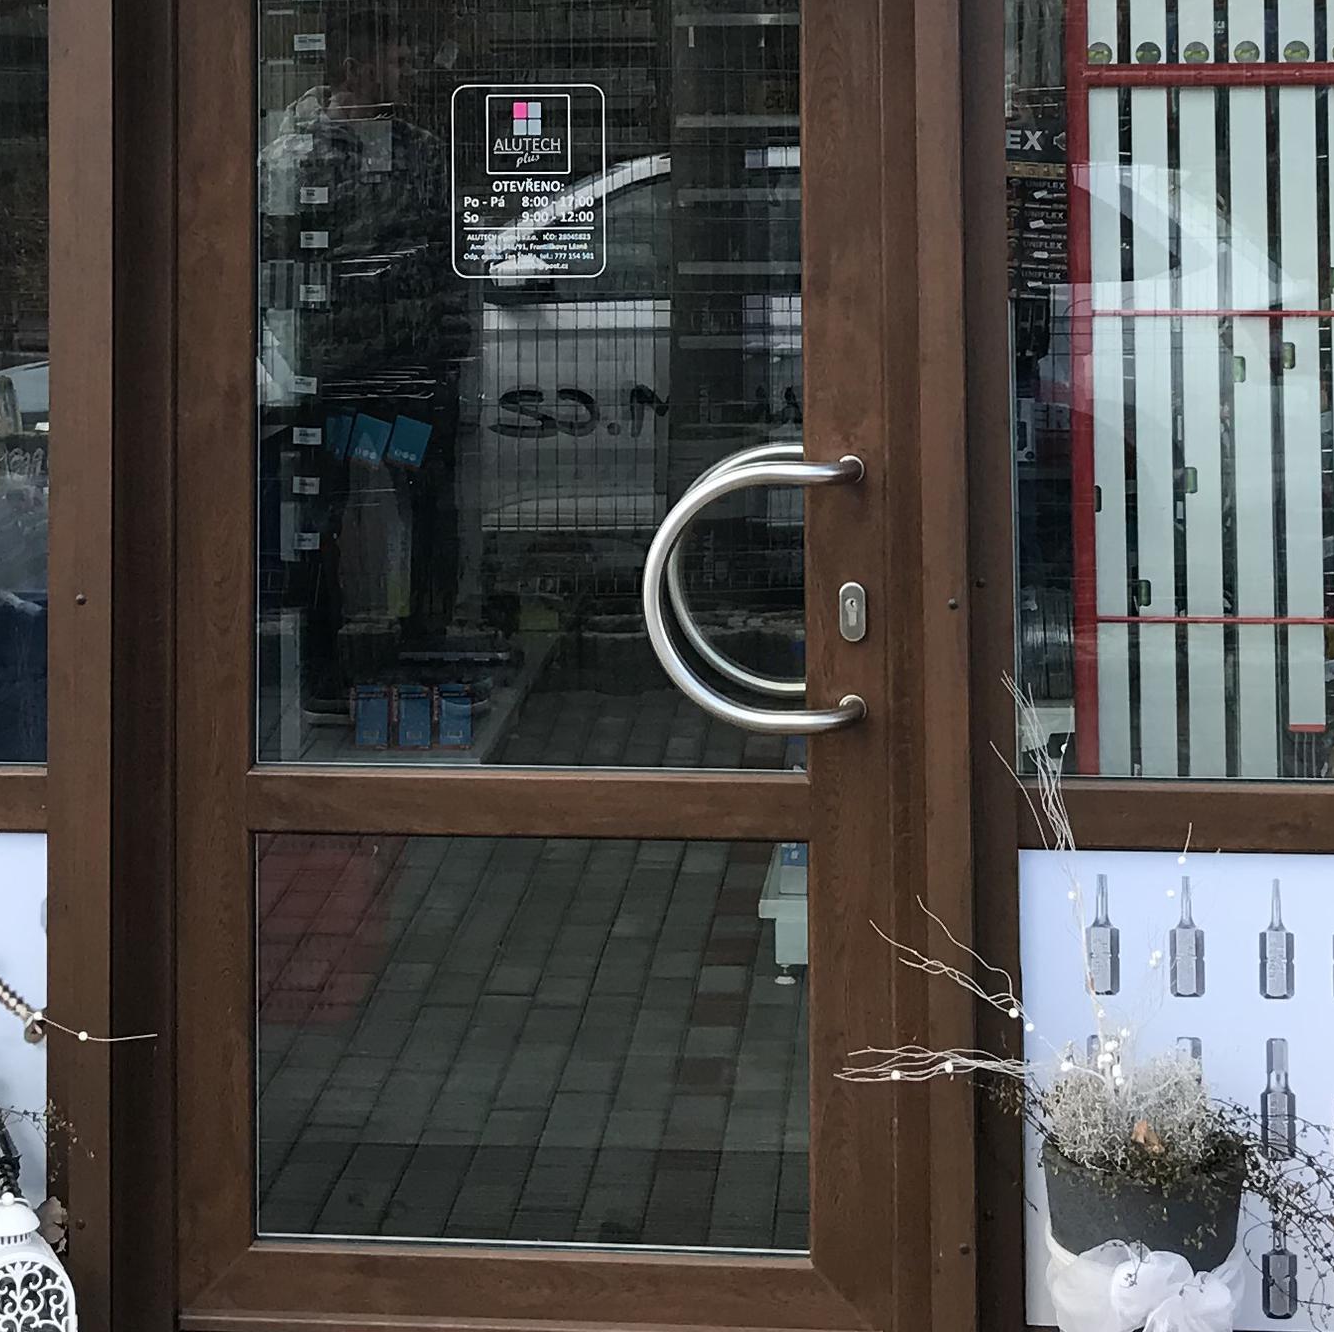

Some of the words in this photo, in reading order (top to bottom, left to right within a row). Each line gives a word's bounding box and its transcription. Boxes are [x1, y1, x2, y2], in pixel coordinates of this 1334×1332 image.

[493, 138, 561, 151] ALUTECH
[516, 151, 541, 168] plus
[492, 178, 565, 193] OTEVŘENO:
[1024, 179, 1066, 191] UNIFLEX
[463, 197, 480, 208] Po
[490, 195, 506, 208] Pá
[521, 196, 549, 208] 8:00
[463, 212, 480, 223] So
[521, 211, 549, 223] 9:00
[561, 211, 594, 223] 12:00
[1023, 210, 1065, 220] UNIFLEX
[1022, 239, 1063, 250] UNIFLEX
[1021, 269, 1062, 281] UNIFLEX
